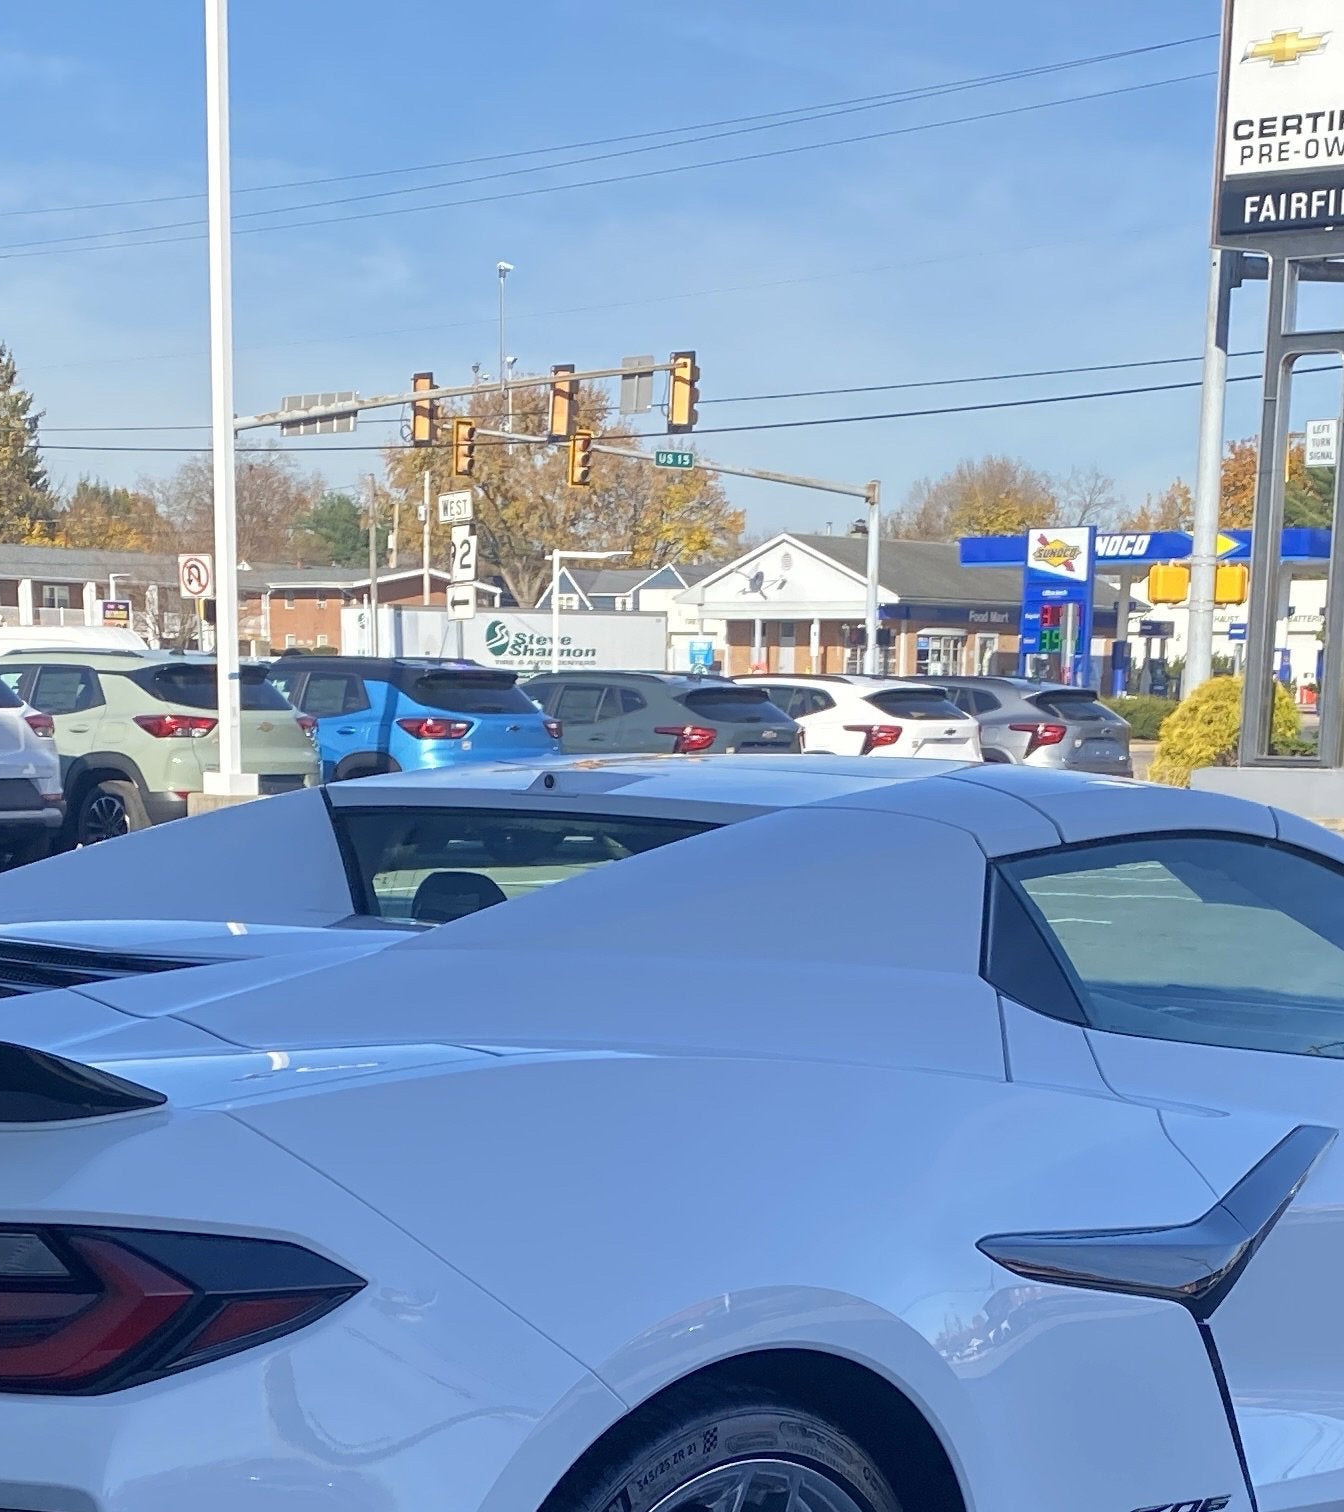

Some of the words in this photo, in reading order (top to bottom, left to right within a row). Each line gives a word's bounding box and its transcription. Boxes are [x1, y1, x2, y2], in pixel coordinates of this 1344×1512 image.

[1312, 424, 1331, 434] LEFT
[1312, 437, 1332, 447] TURN
[658, 453, 674, 464] US
[677, 454, 690, 465] 15
[1309, 451, 1335, 460] SIGNAL
[441, 499, 468, 517] WEST
[1035, 547, 1078, 559] SUNOCO
[969, 610, 989, 622] Food
[990, 611, 1010, 623] Mart
